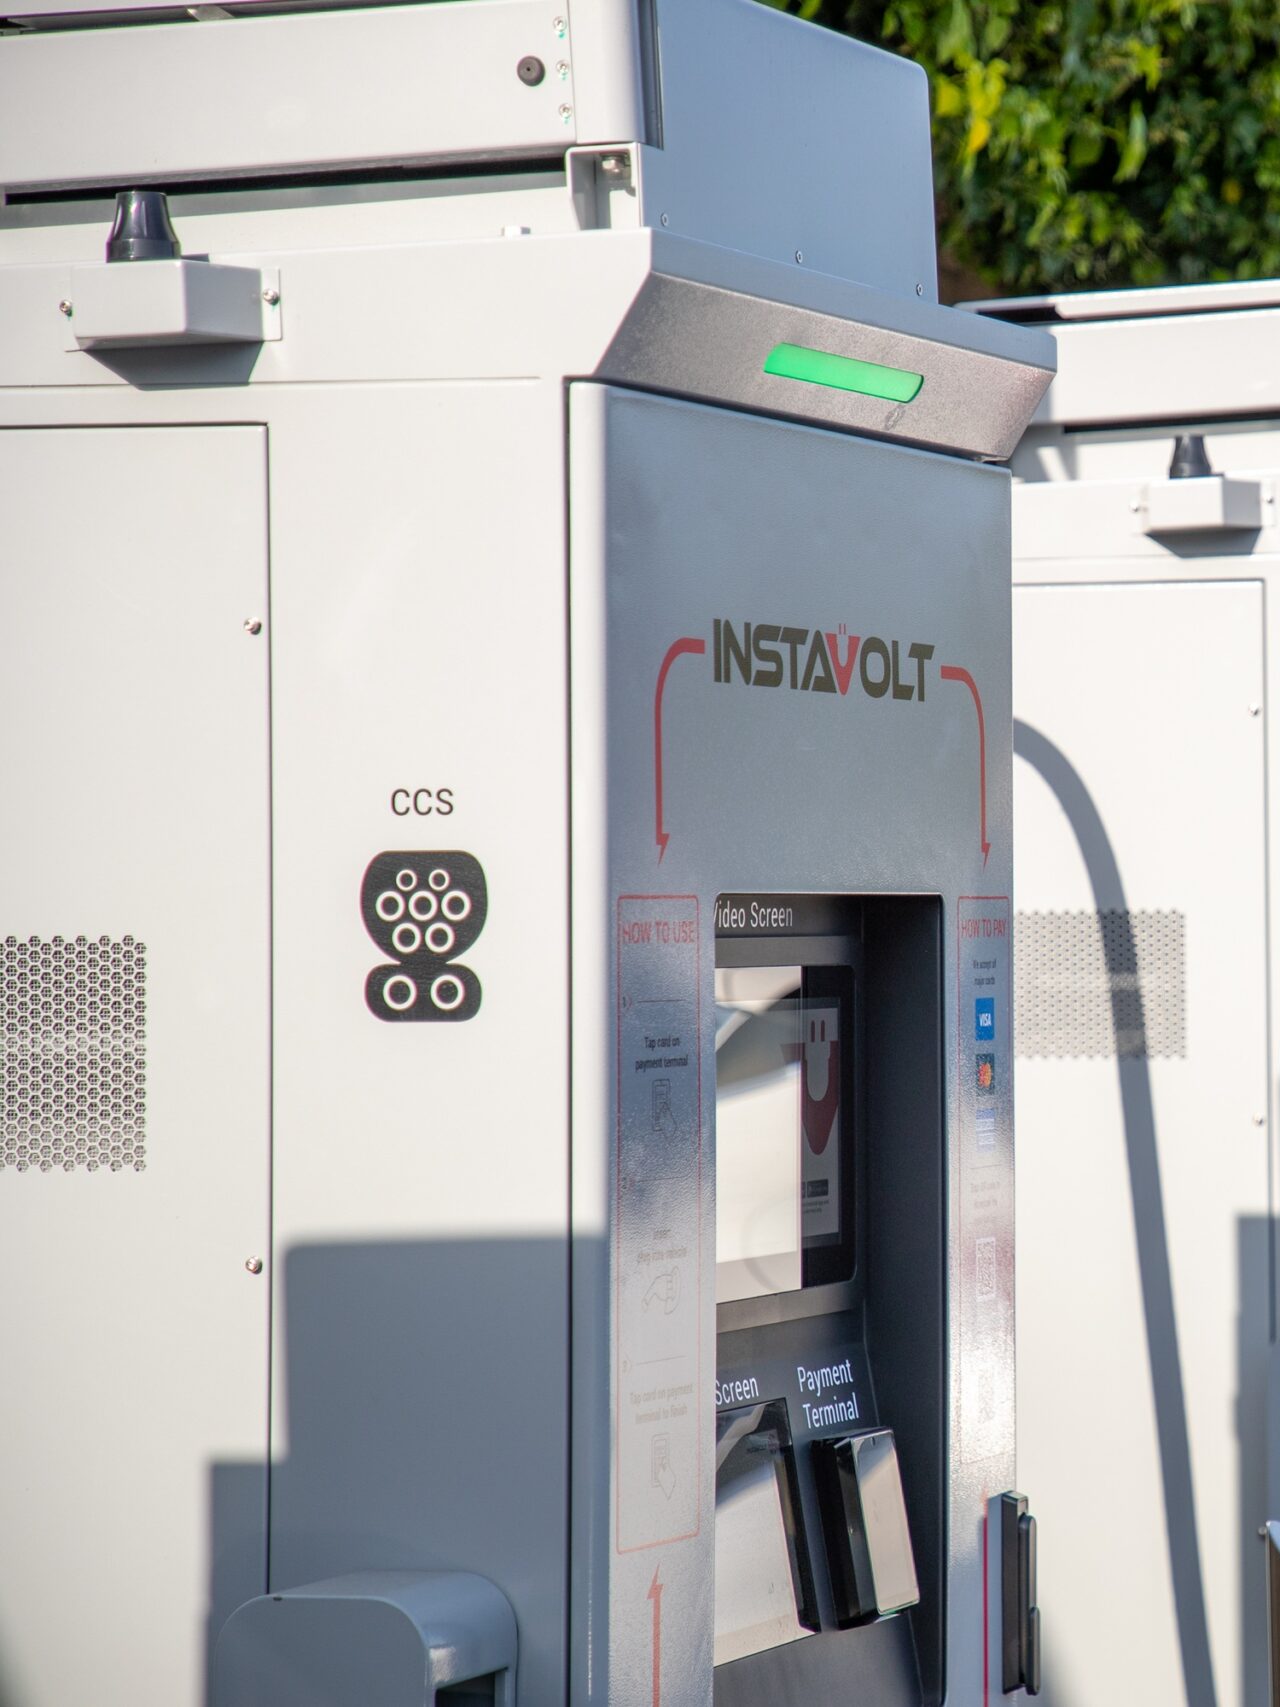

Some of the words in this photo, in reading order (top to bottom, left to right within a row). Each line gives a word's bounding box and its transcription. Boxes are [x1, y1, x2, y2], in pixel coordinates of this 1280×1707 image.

[713, 618, 935, 702] INSTAVOLT
[391, 788, 454, 816] CCS
[750, 901, 793, 928] Screen
[961, 919, 980, 938] HOW
[982, 919, 992, 937] TO
[993, 918, 1007, 937] PAY
[622, 921, 652, 945] HOW
[655, 919, 670, 944] TO
[673, 920, 695, 944] USE
[979, 1012, 992, 1028] VISA
[715, 1376, 760, 1406] Screen
[796, 1359, 854, 1397] Payment
[802, 1391, 860, 1430] Terminal
